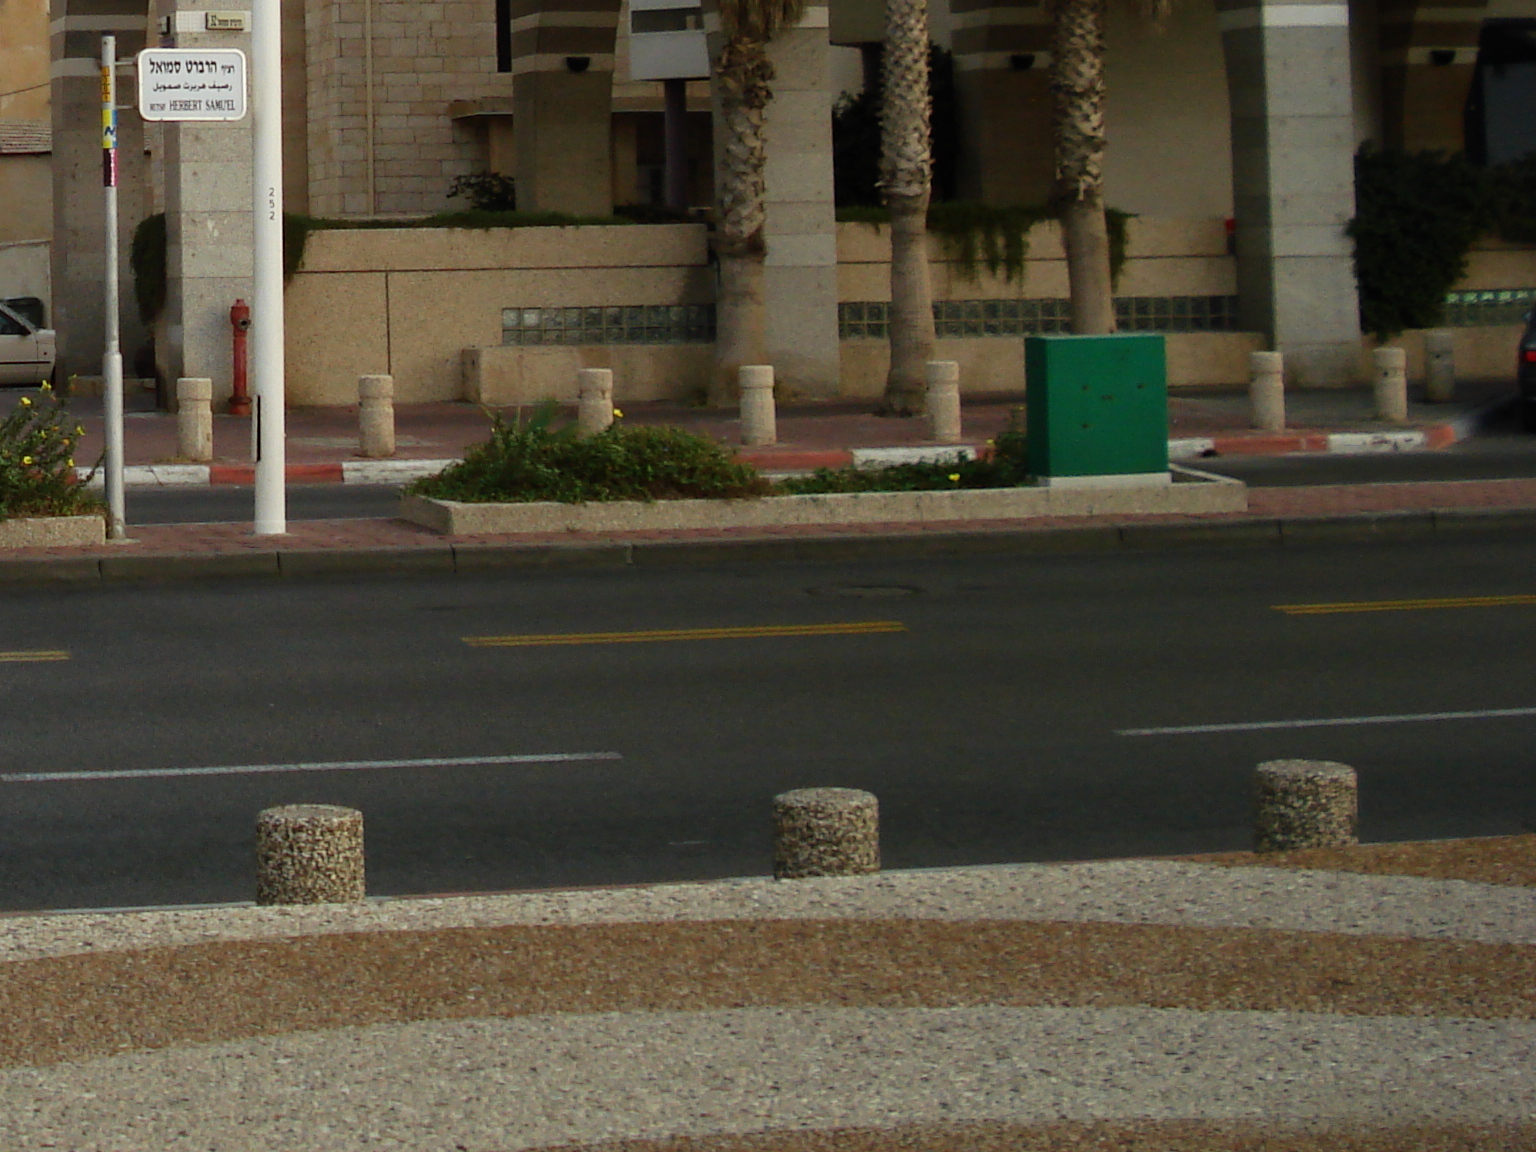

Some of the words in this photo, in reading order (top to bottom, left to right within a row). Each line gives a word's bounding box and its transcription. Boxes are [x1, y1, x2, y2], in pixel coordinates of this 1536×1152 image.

[149, 57, 181, 74] סמואל
[185, 59, 217, 74] הרברט
[169, 99, 202, 111] HERBERT
